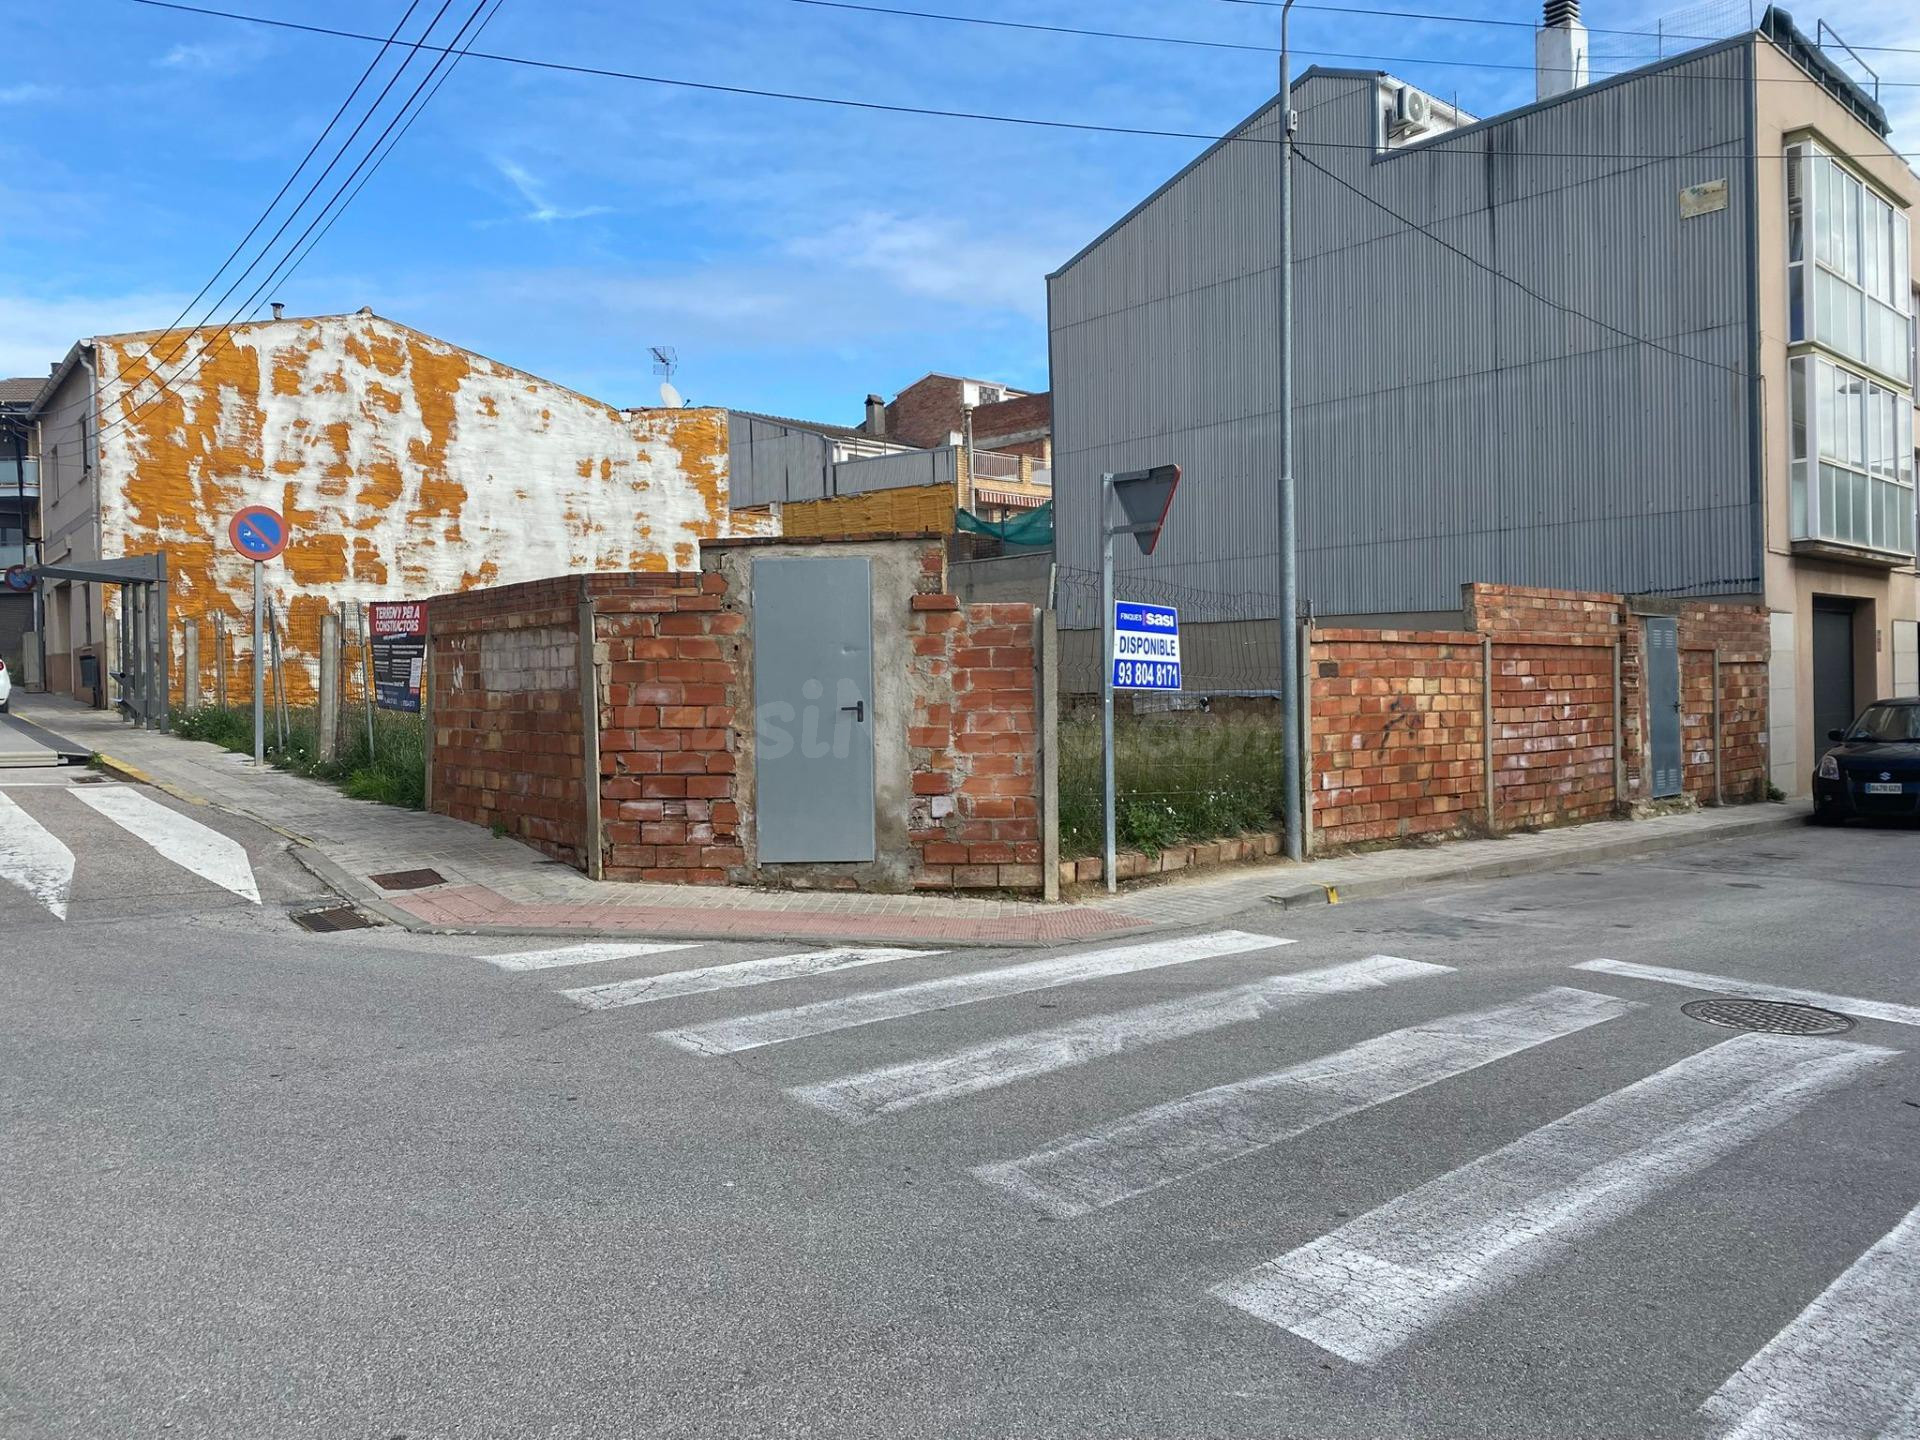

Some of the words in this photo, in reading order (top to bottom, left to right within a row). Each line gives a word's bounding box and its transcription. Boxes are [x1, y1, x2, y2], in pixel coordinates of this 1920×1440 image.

[1120, 636, 1176, 656] DISPONIBLE
[1118, 662, 1132, 685] 93
[1135, 663, 1154, 685] 804
[1156, 664, 1178, 686] 8171
